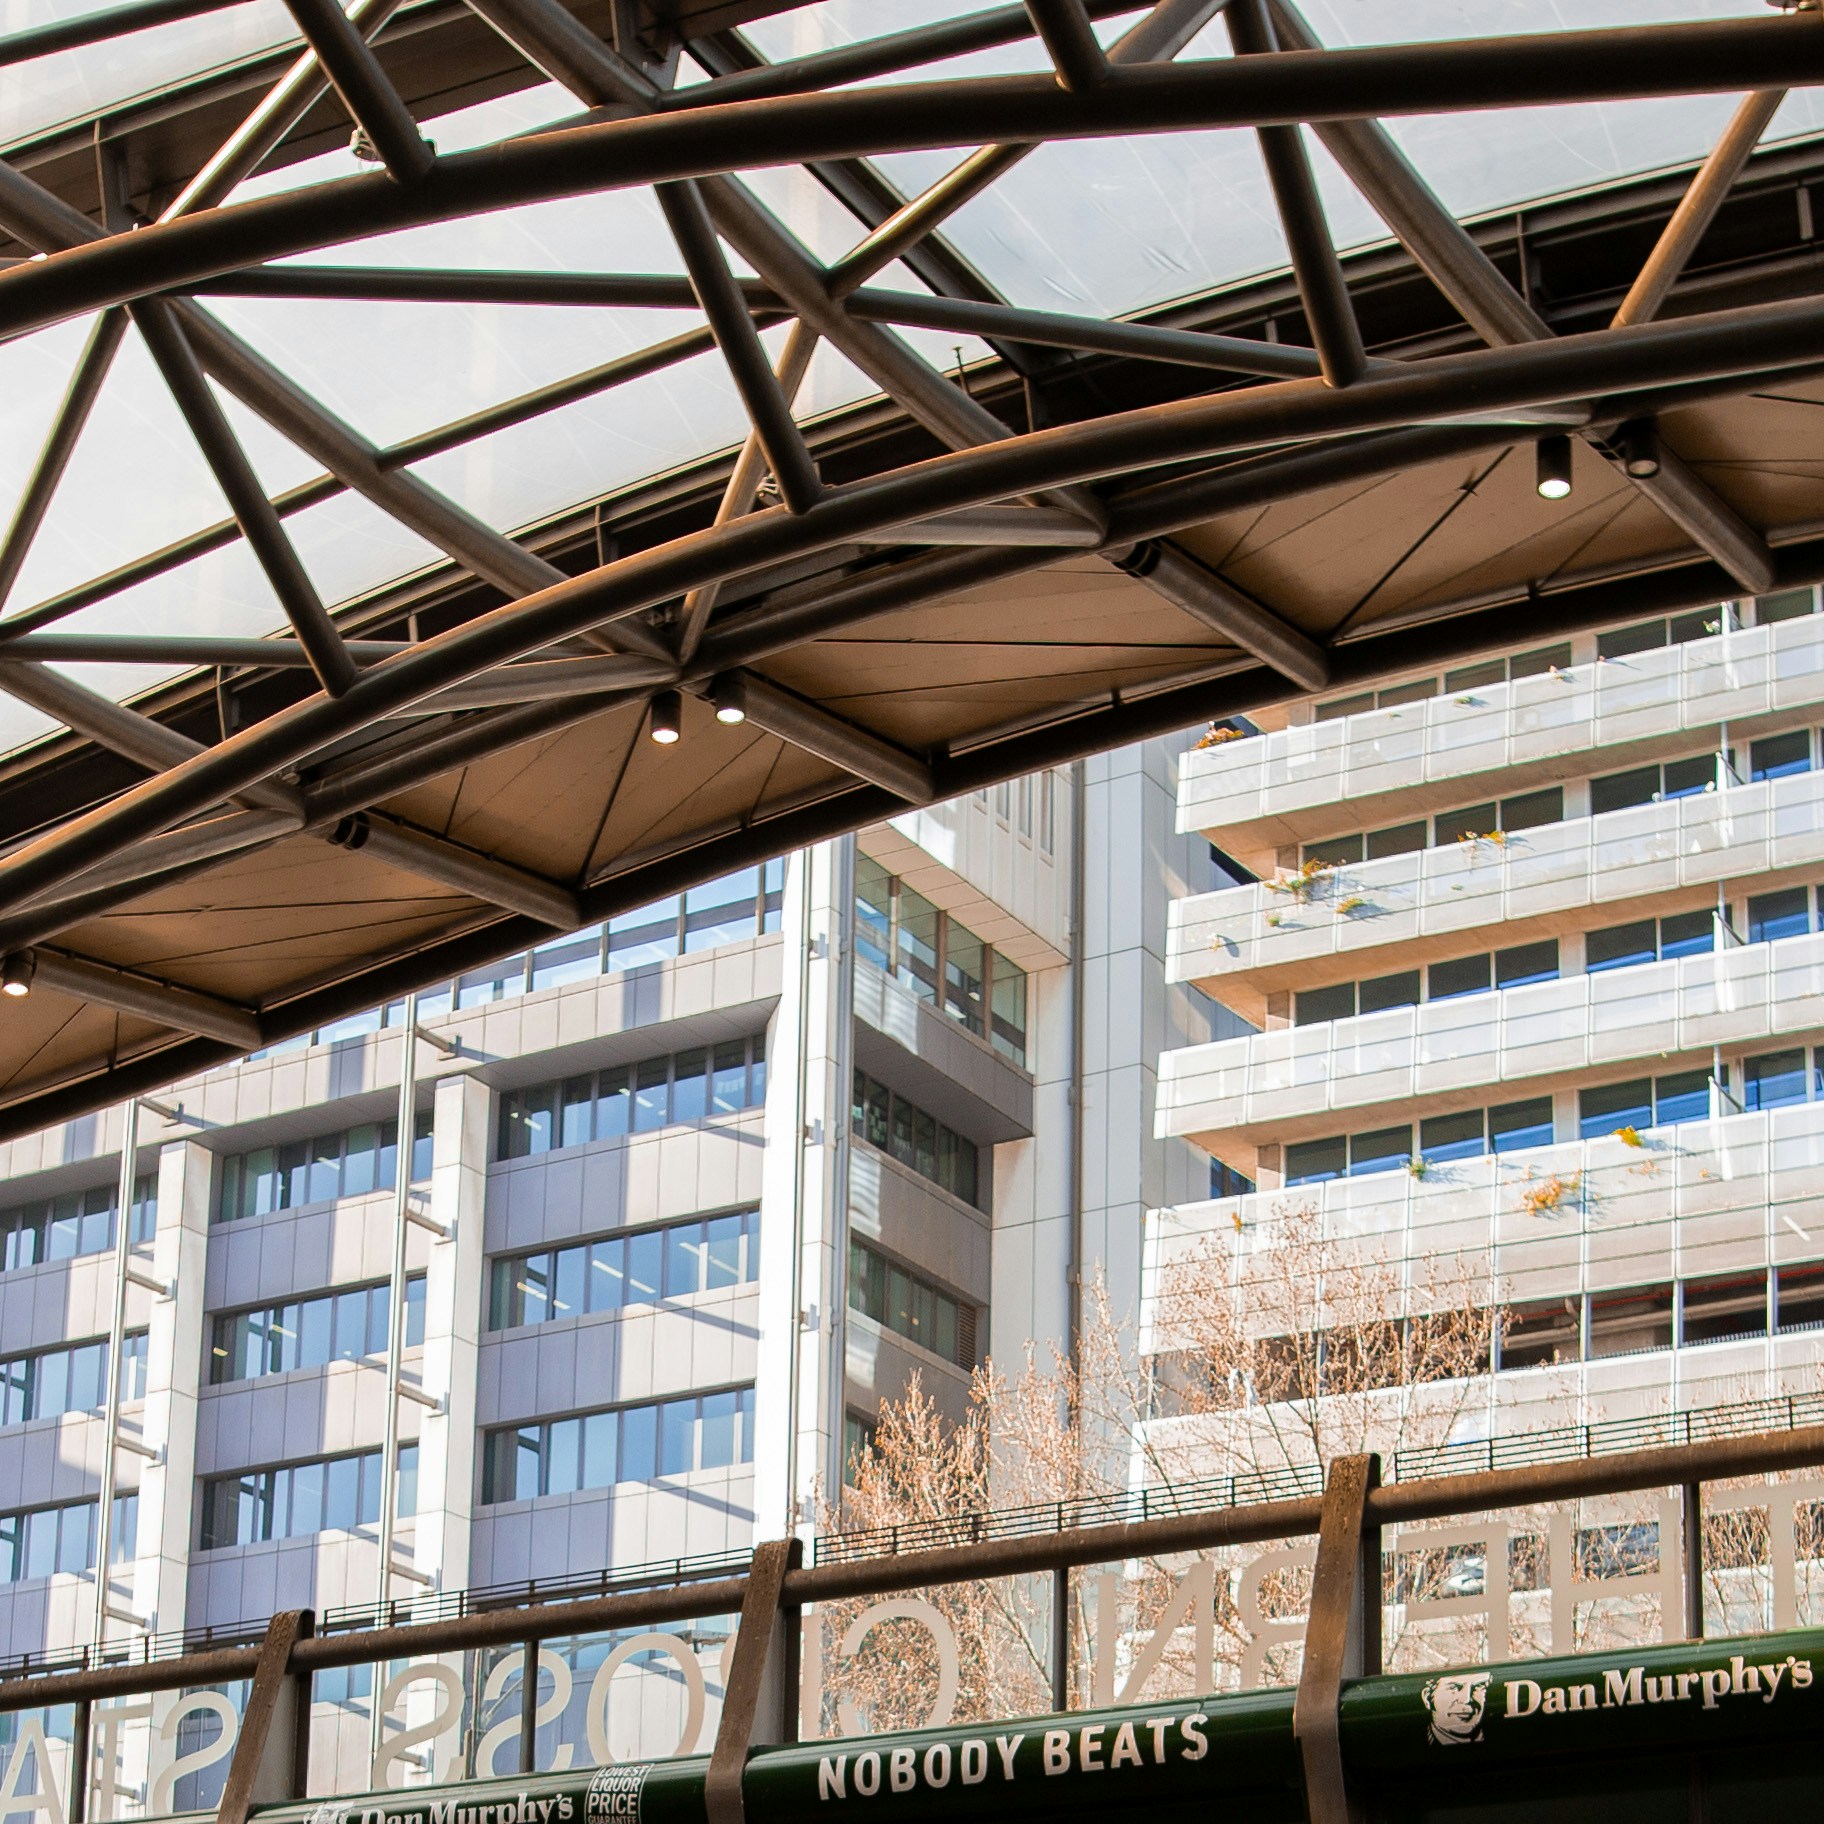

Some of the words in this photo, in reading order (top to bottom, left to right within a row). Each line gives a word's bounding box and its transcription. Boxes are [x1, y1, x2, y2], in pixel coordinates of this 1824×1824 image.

[818, 1734, 1025, 1801] NOBODY
[1043, 1714, 1209, 1776] BEATS
[598, 1765, 649, 1778] LOWEST
[591, 1777, 641, 1792] LIQUOR
[587, 1793, 637, 1814] PRICE
